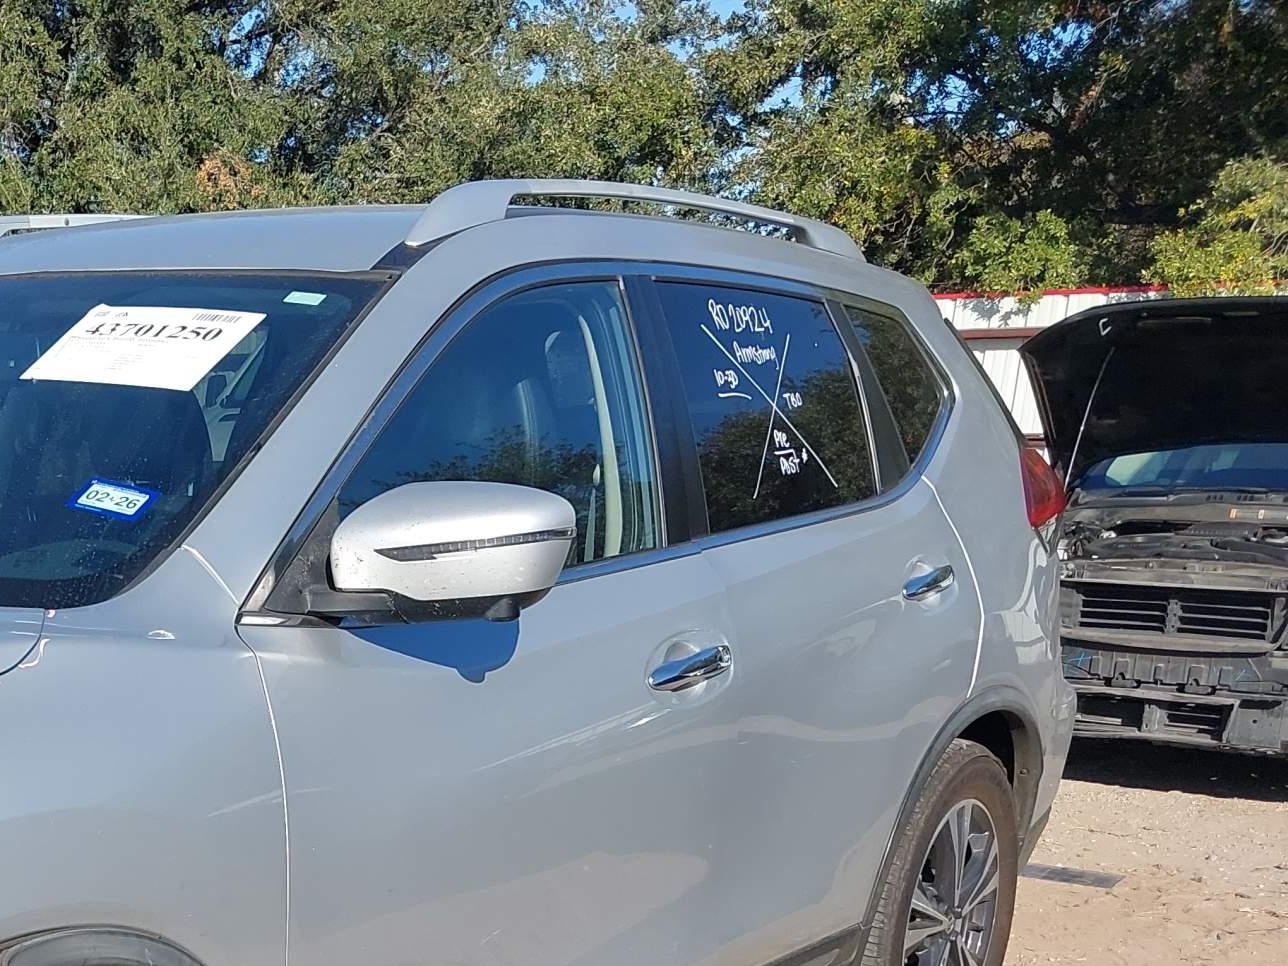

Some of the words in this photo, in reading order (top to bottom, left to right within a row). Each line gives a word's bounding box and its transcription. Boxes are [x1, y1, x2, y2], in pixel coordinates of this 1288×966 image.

[85, 322, 224, 342] 43701250
[733, 342, 779, 370] Armstrong
[86, 490, 110, 502] 02
[114, 497, 140, 509] 26
